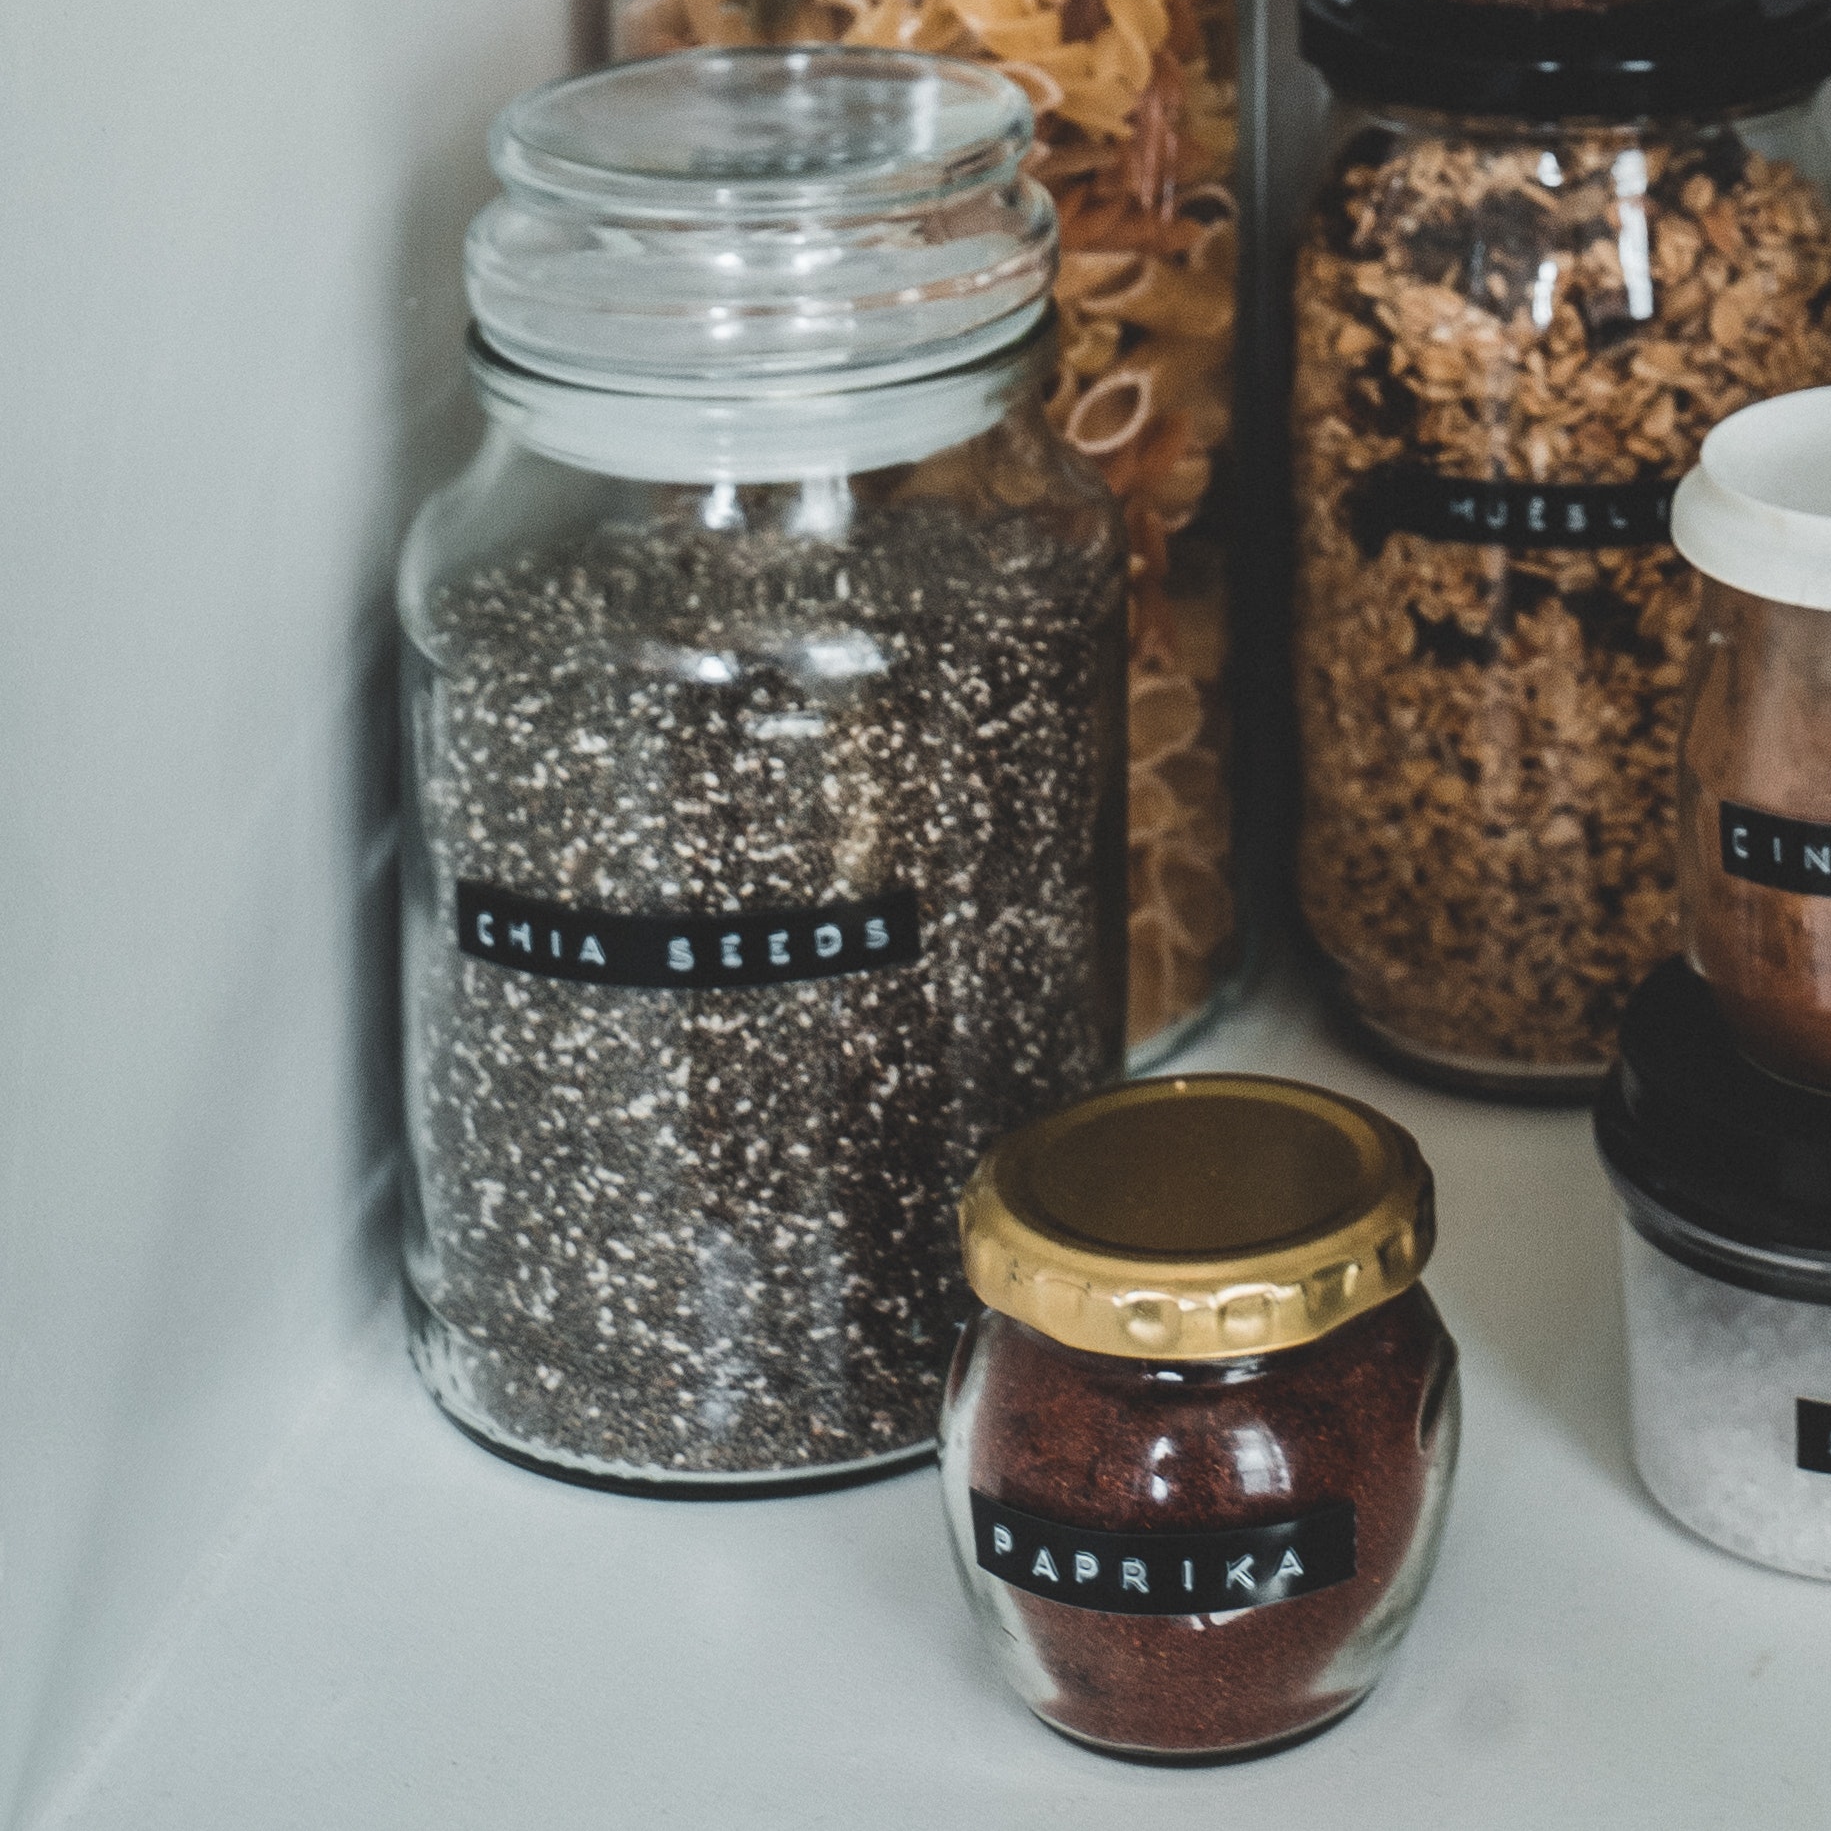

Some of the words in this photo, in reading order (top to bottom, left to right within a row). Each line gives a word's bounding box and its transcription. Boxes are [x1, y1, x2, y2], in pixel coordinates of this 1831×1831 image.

[477, 911, 606, 966] CHIA
[667, 917, 890, 971] SEEDS
[994, 1522, 1304, 1594] PAPRIKA
